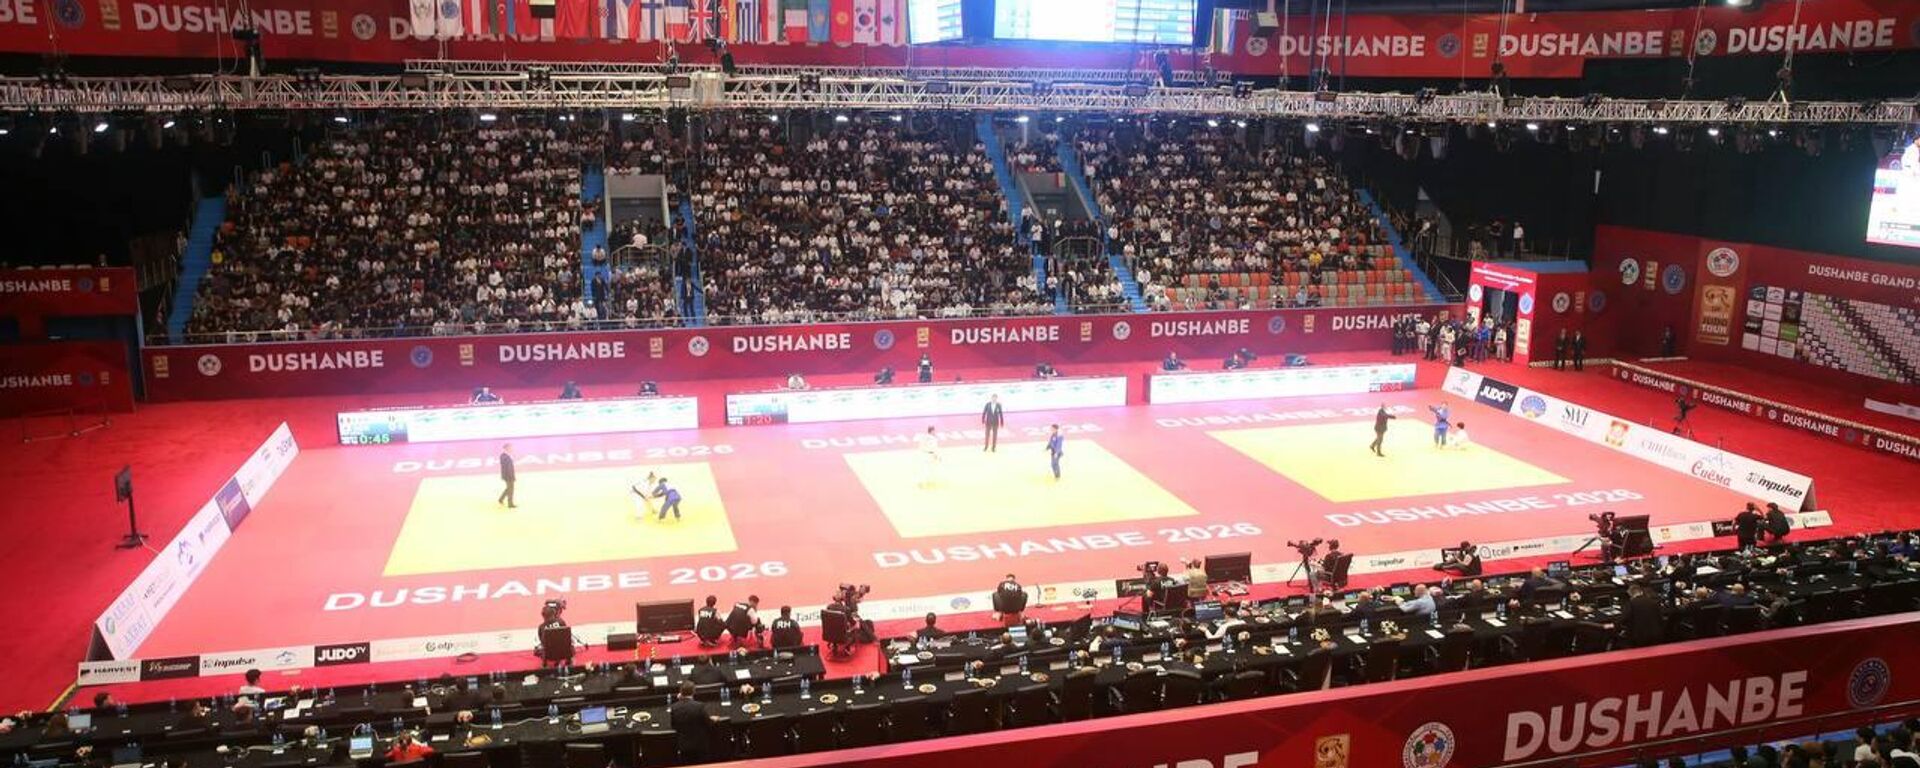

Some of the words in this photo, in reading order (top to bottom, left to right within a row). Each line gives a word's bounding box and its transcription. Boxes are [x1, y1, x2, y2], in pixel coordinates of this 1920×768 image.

[133, 3, 313, 35] DUSHANBE
[1279, 35, 1425, 57] DUSHANBE
[1500, 31, 1663, 57] DUSHANBE
[1727, 19, 1897, 53] DUSHANBE
[1808, 265, 1869, 283] DUSHANBE
[1872, 271, 1914, 289] GRAND
[951, 326, 1060, 345] DUSHANBE
[1151, 318, 1250, 337] DUSHANBE
[499, 342, 625, 362] DUSHANBE
[733, 333, 851, 353] DUSHANBE
[249, 350, 384, 373] DUSHANBE
[1633, 373, 1676, 393] DUSHANBE
[1702, 392, 1752, 413] DUSHANBE
[1783, 413, 1839, 438] DUSHANBE
[644, 444, 735, 460] 2026
[1757, 475, 1803, 499] impulse
[1324, 495, 1557, 527] DUSHANBE
[1553, 488, 1644, 507] 2026
[872, 532, 1153, 569] DUSHANBE
[1158, 522, 1263, 544] 2026
[323, 571, 652, 611] DUSHANBE
[670, 561, 790, 585] 2026
[777, 621, 791, 629] RH
[214, 657, 256, 669] impulse
[1503, 670, 1808, 761] DUSHANBE
